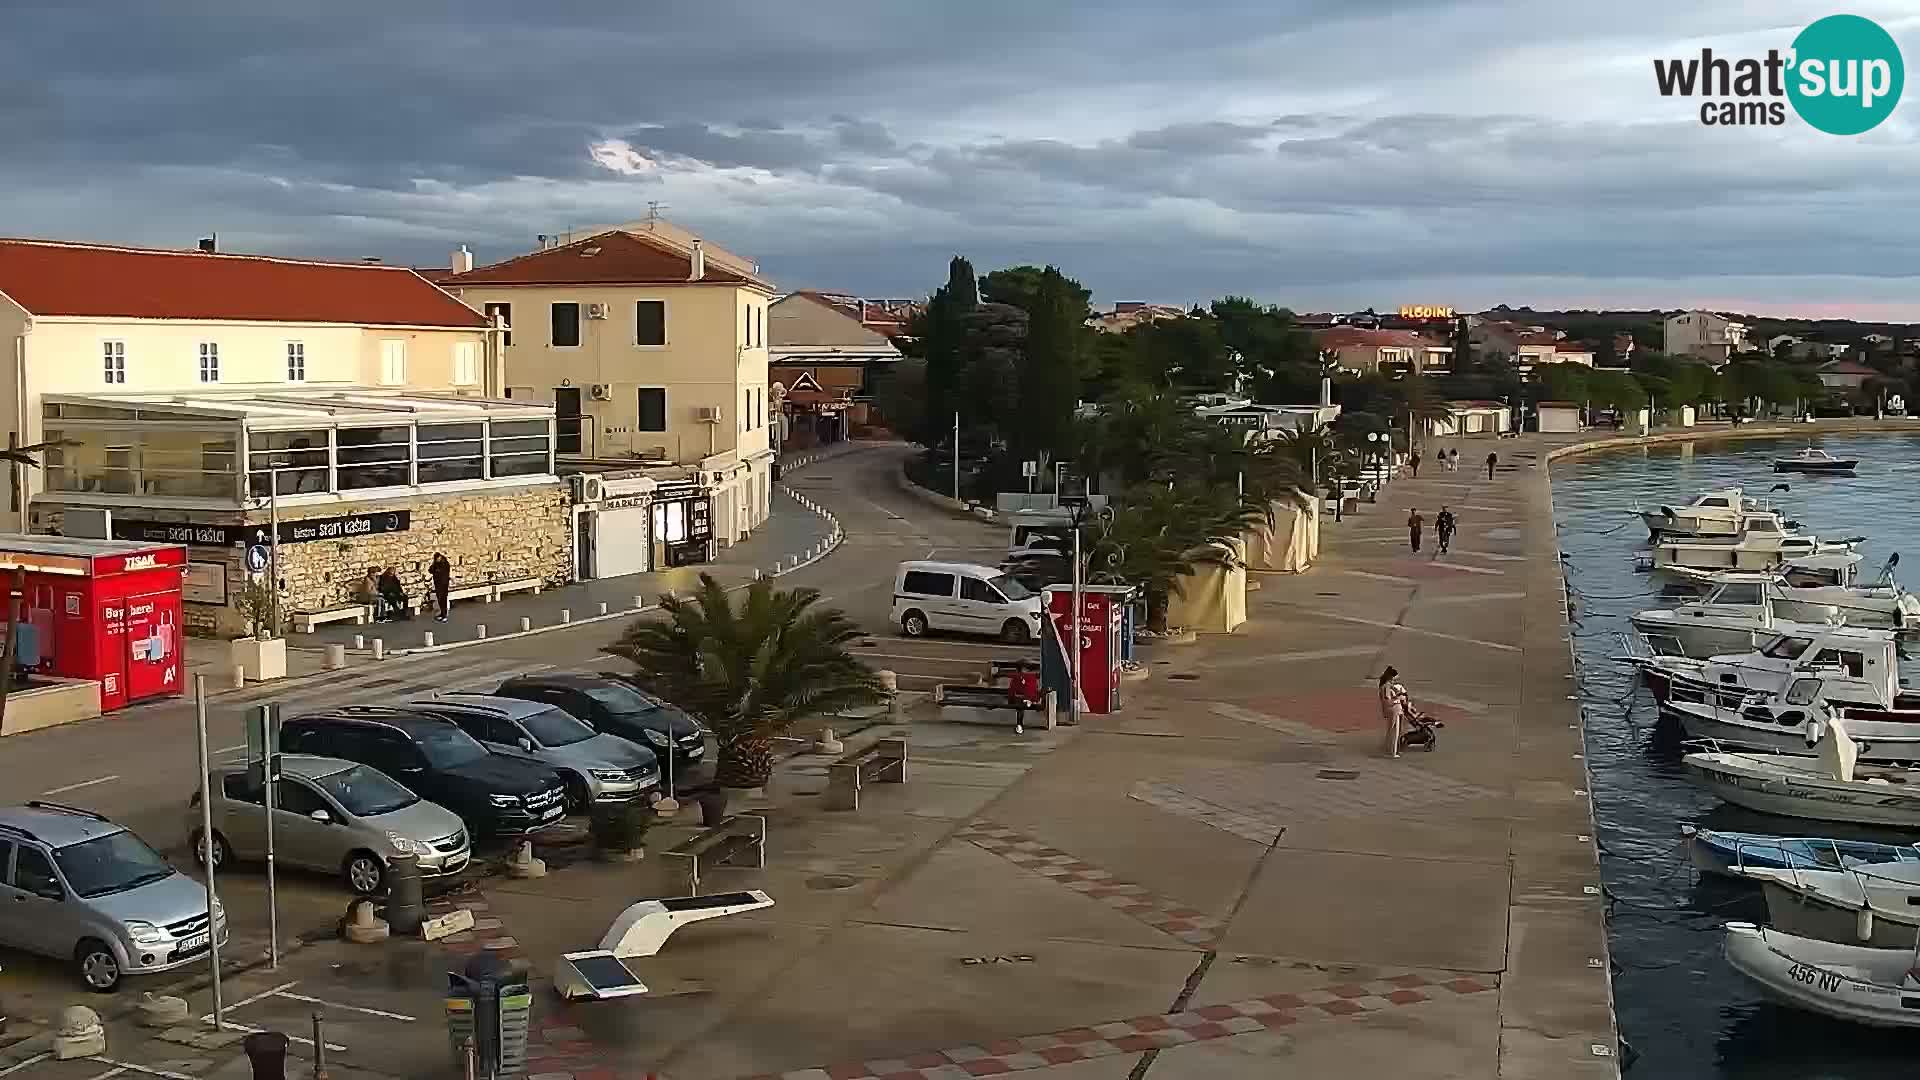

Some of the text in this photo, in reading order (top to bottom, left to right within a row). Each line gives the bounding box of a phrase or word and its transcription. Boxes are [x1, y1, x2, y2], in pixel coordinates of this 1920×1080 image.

[1401, 305, 1454, 318] PLODINE
[124, 554, 155, 571] TISAK
[105, 606, 125, 620] Buy
[1787, 963, 1842, 993] 456 NV
